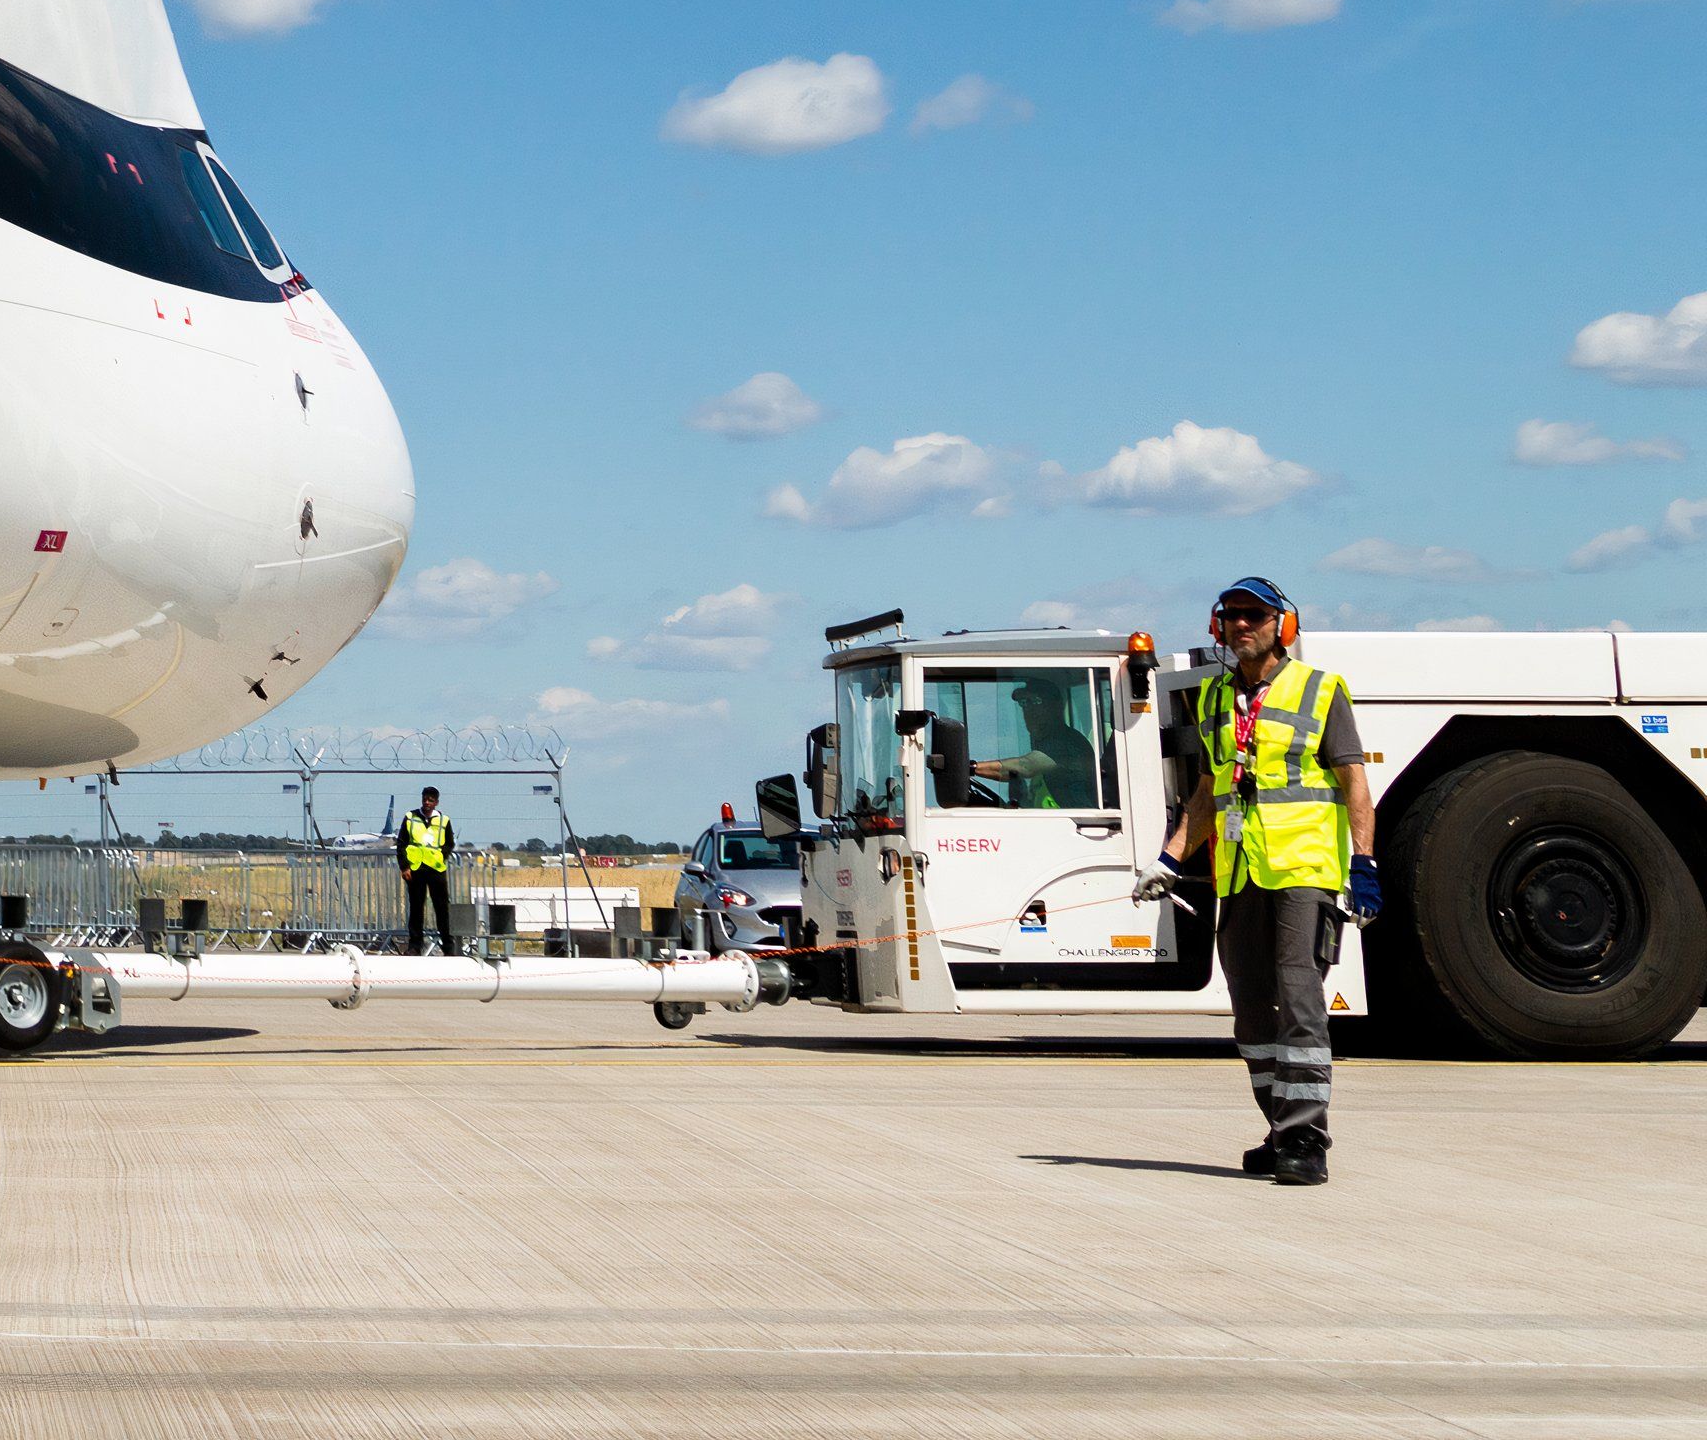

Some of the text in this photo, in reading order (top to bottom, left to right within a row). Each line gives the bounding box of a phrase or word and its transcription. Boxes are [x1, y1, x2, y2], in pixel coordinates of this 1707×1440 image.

[937, 839, 1001, 852] HiSERV
[1058, 948, 1168, 958] CHALLENGER 700
